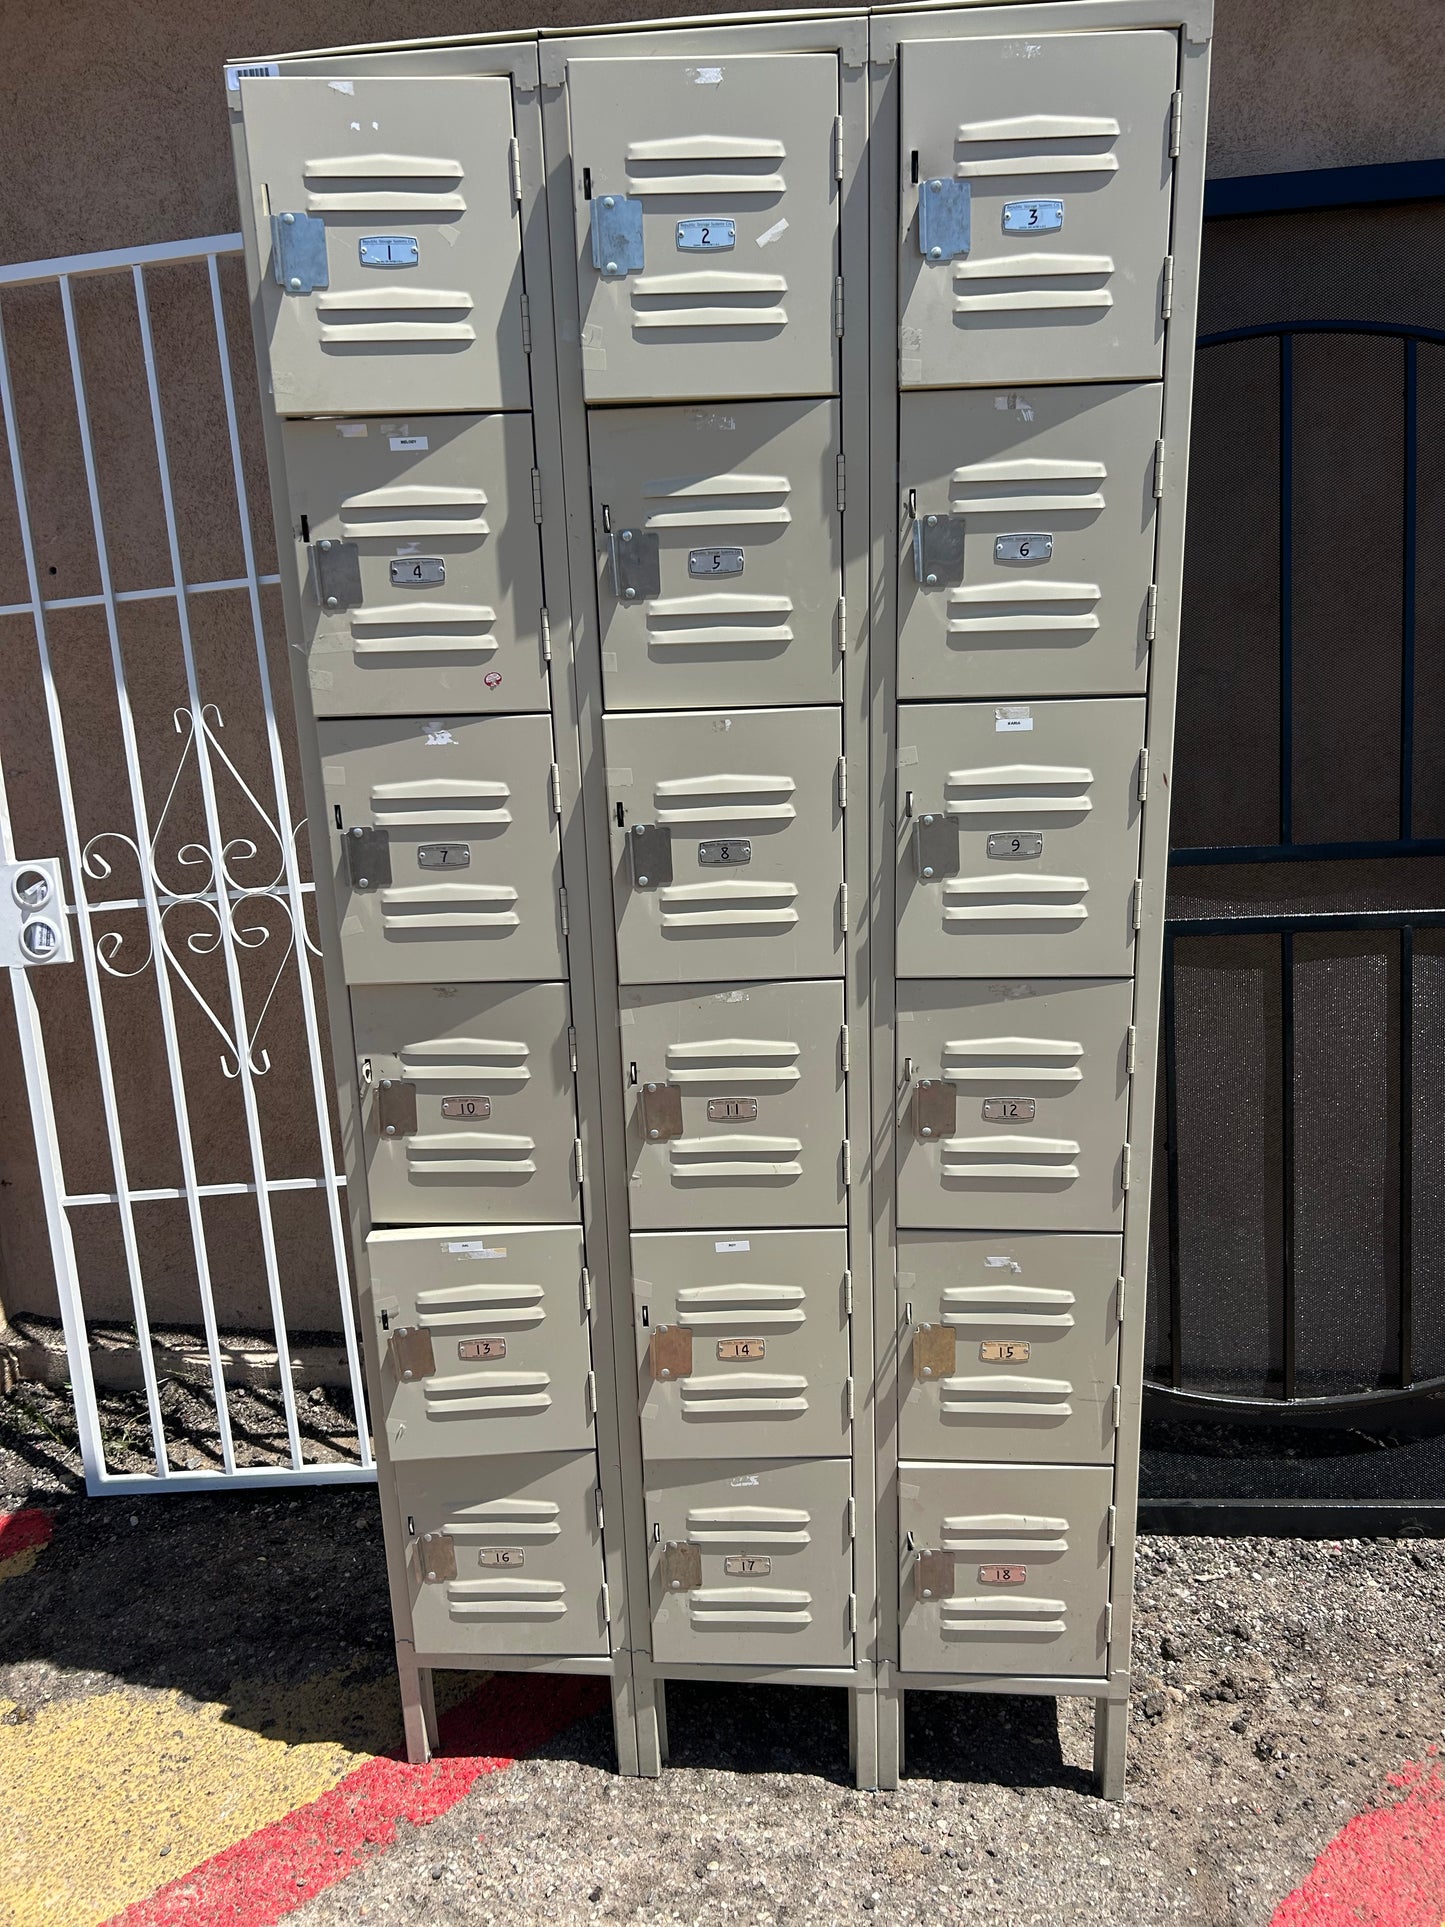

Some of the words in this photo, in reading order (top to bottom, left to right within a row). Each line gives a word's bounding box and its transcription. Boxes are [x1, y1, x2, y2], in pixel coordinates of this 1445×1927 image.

[1027, 208, 1038, 226] 3
[701, 227, 711, 244] 2
[387, 244, 392, 261] 1
[1019, 541, 1030, 557] 6
[712, 555, 721, 570] 5
[413, 564, 423, 579] 4
[1011, 838, 1021, 852] 9
[439, 850, 449, 863] 7
[720, 846, 730, 860] 8
[460, 1102, 475, 1116] 10
[726, 1103, 739, 1116] 11
[1003, 1103, 1018, 1117] 12
[476, 1343, 491, 1356] 13
[735, 1343, 750, 1356] 14
[999, 1346, 1014, 1359] 15
[496, 1552, 510, 1563] 16
[742, 1560, 755, 1572] 17
[996, 1569, 1011, 1580] 18
